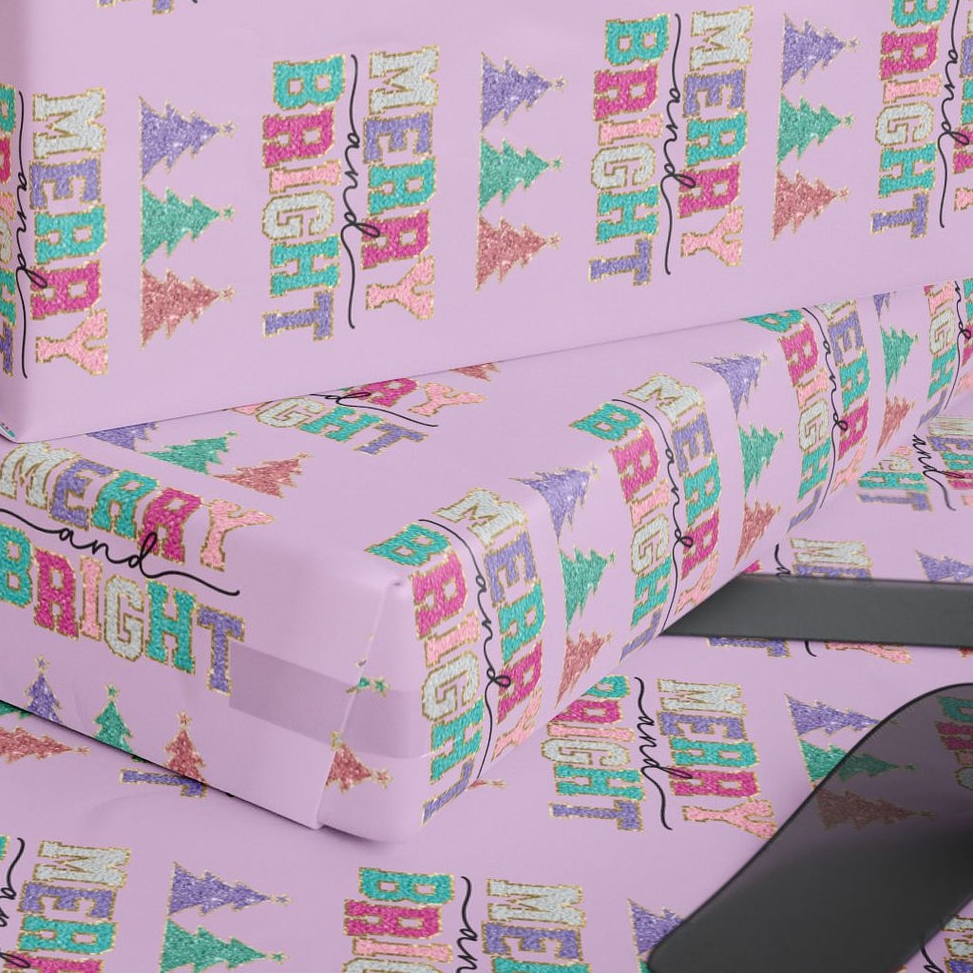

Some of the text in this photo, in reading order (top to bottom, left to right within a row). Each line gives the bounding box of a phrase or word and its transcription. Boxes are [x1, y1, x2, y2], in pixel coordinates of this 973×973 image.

[28, 87, 109, 377] MERRY
[261, 53, 346, 342] BRIGHT
[360, 44, 440, 321] MERRY
[588, 12, 672, 287] BRIGHT
[678, 5, 755, 268] MERRY
[634, 675, 694, 831] and
[656, 677, 779, 841] MERRY
